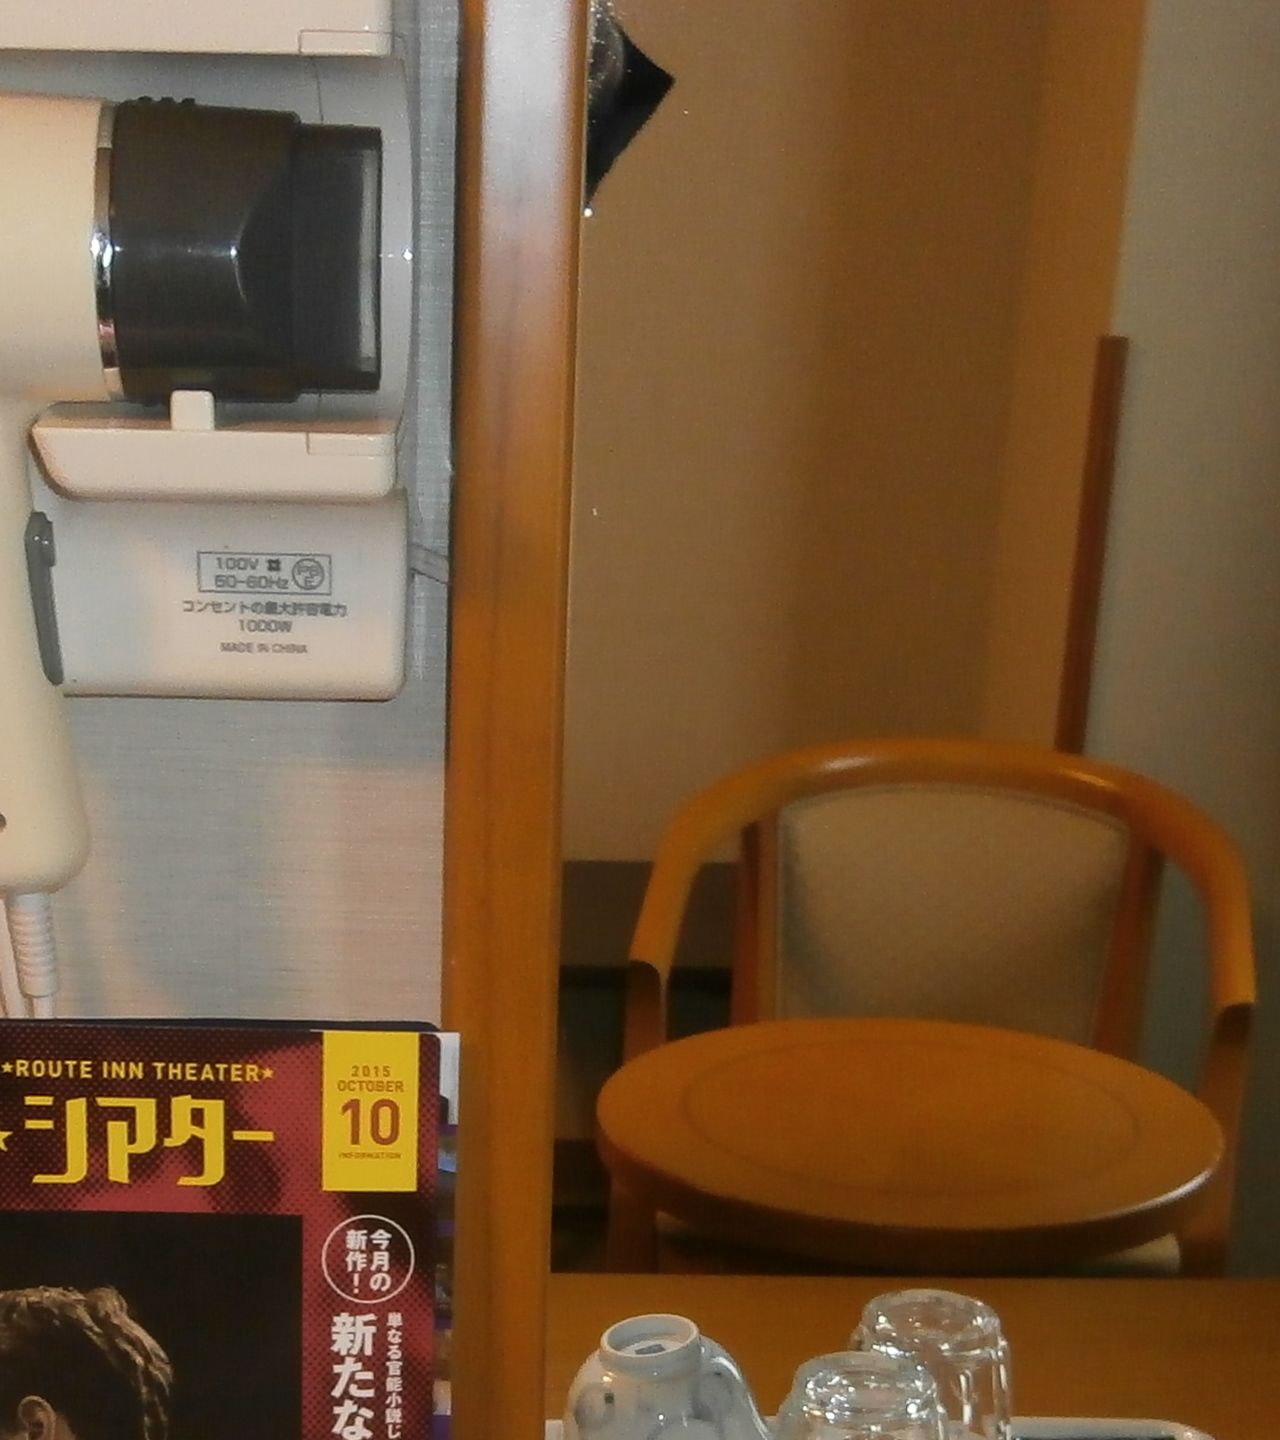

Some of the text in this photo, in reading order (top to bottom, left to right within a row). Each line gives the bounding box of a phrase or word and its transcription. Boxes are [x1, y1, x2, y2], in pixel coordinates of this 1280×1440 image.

[216, 557, 258, 570] 100V
[239, 619, 292, 633] 1000W
[220, 642, 253, 653] MADE
[272, 643, 308, 654] CHINA
[16, 1059, 93, 1079] ROUTE
[102, 1061, 144, 1080] INN
[153, 1062, 259, 1082] THEATER
[351, 1065, 391, 1077] 2015
[337, 1080, 404, 1093] OCTOBER
[341, 1098, 400, 1146] 10
[370, 1229, 392, 1292] 今月の
